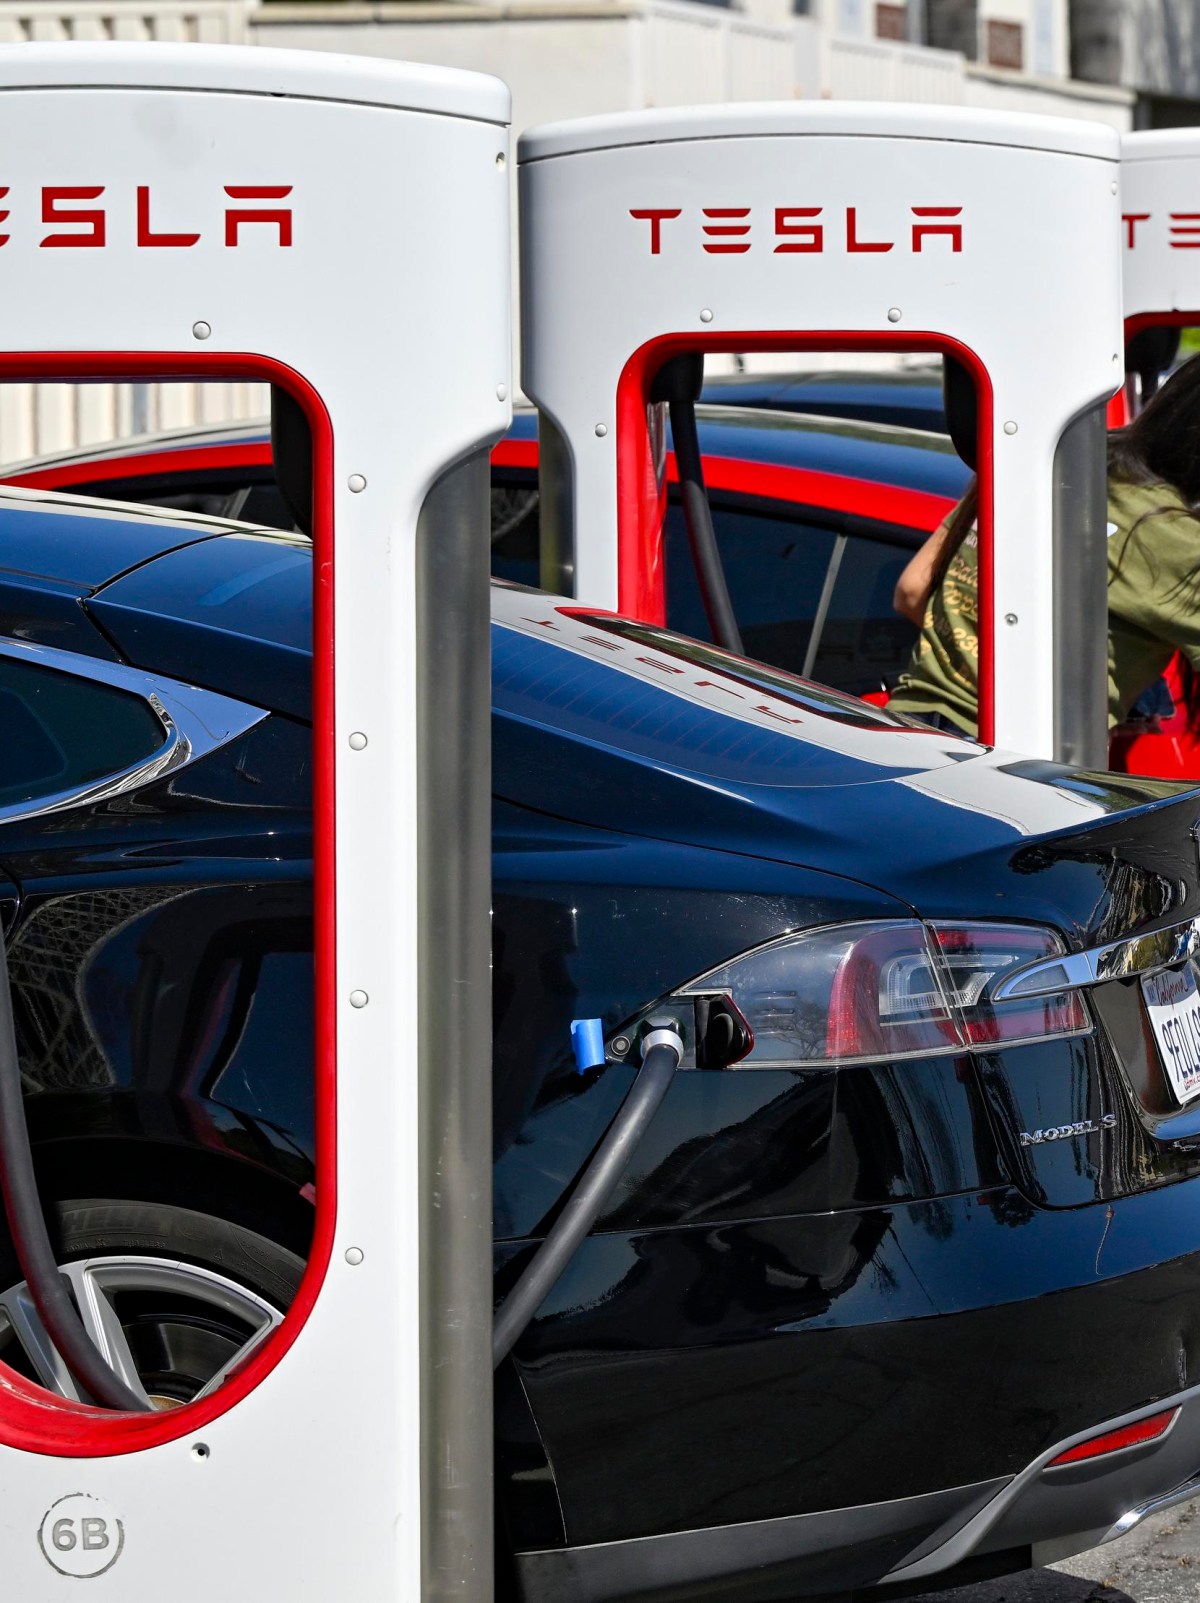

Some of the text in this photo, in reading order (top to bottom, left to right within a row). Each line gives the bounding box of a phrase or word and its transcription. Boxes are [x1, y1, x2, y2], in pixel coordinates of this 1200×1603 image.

[0, 186, 293, 248] SLA
[630, 207, 962, 255] TESLA
[1020, 1113, 1117, 1146] MODEL S
[52, 1518, 109, 1551] 6B
